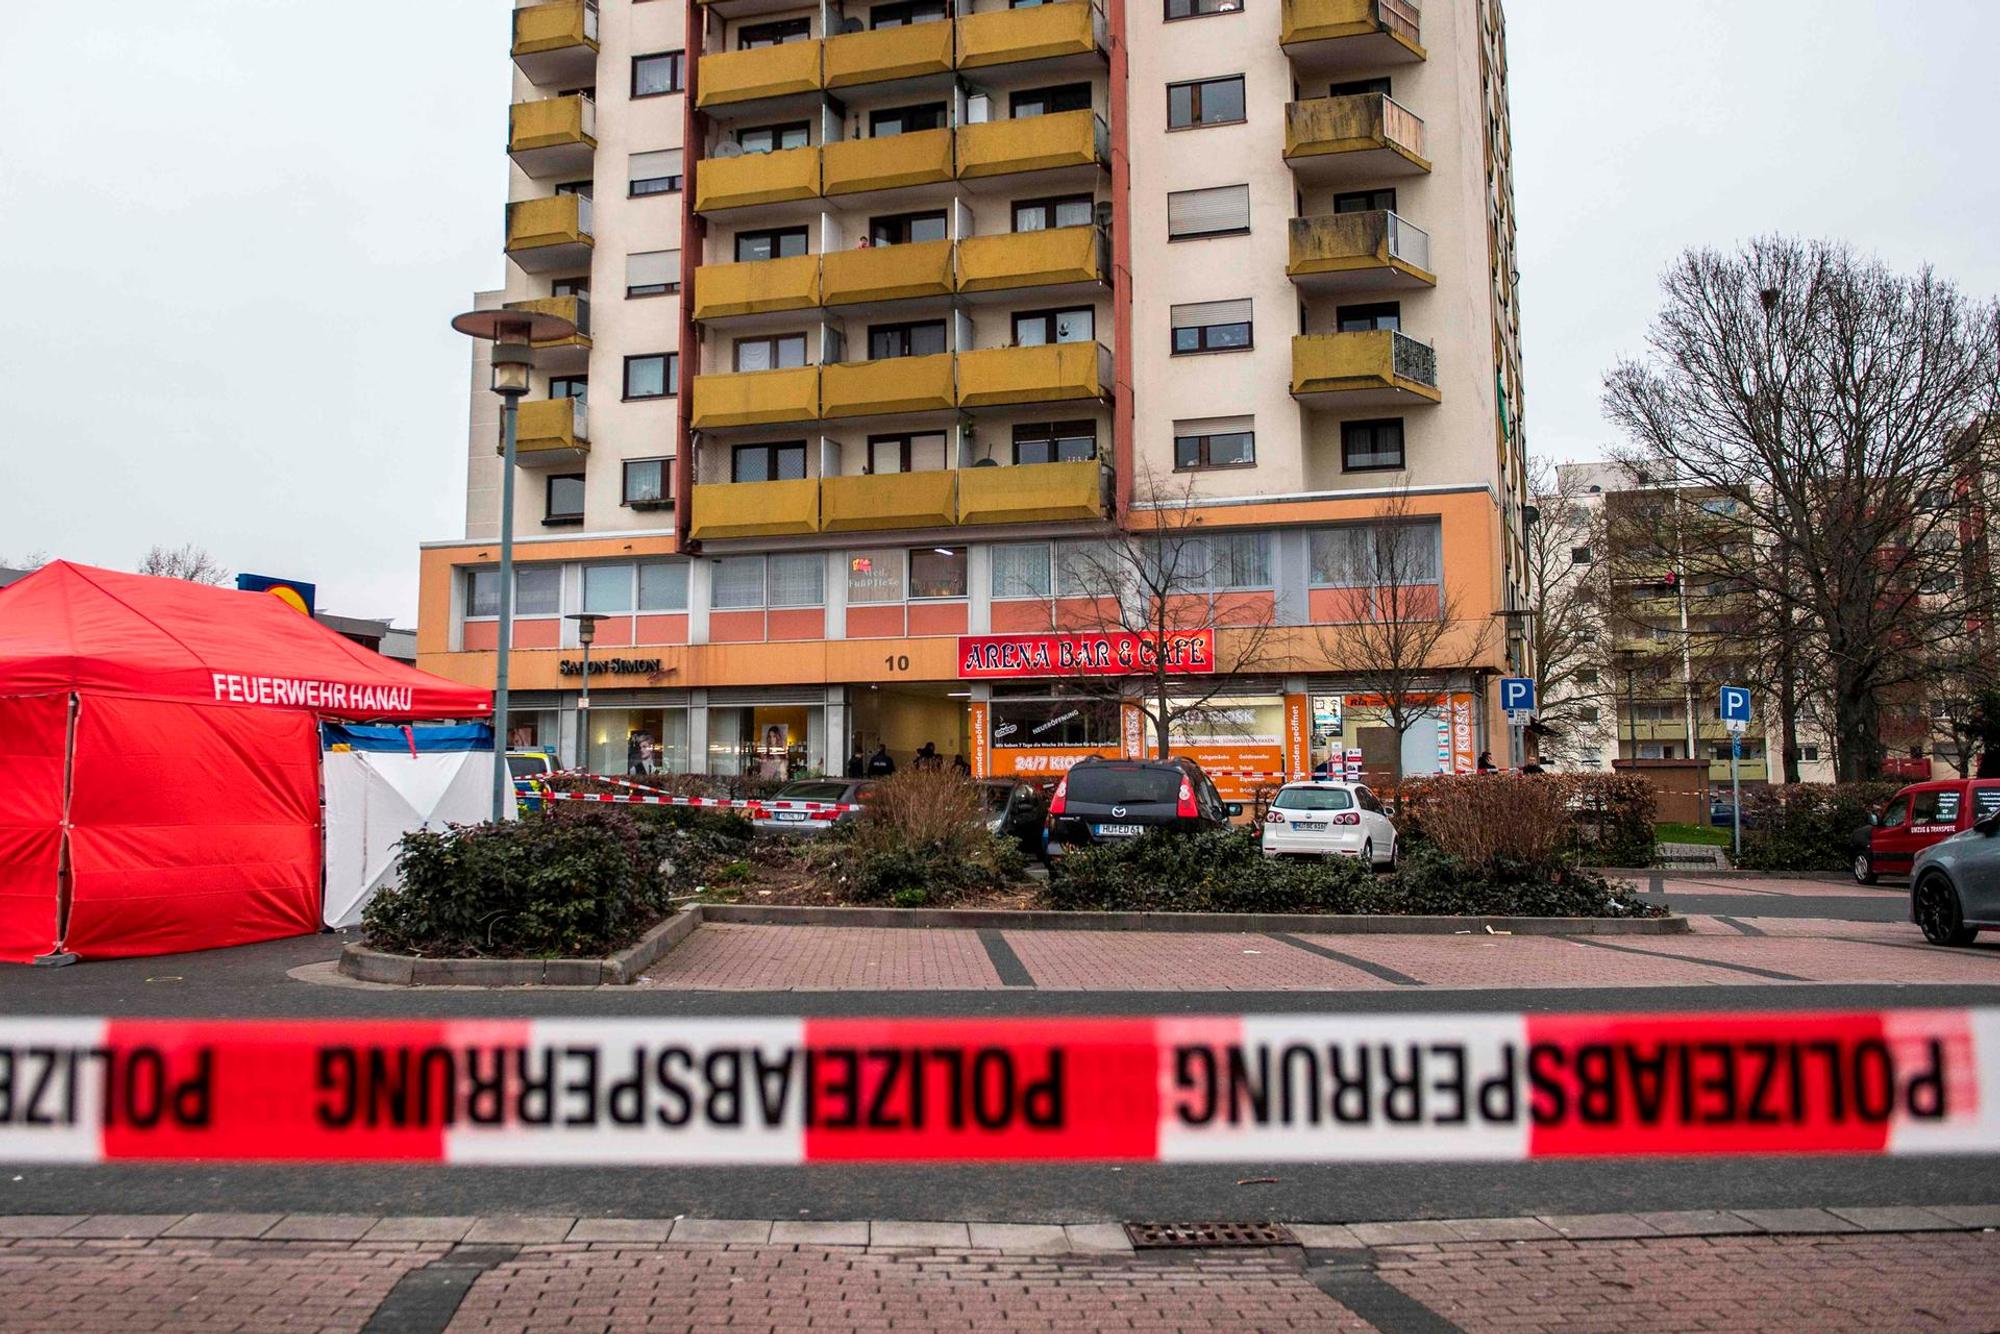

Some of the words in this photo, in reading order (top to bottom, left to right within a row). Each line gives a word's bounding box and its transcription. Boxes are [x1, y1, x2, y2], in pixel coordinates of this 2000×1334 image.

[609, 657, 662, 674] SIMON
[884, 655, 909, 672] 10
[965, 641, 1050, 670] ARENA
[1058, 640, 1110, 668] BAR
[1119, 639, 1133, 666] &
[212, 673, 348, 709] FEUERWEHR
[349, 684, 413, 711] HANAU
[1508, 682, 1526, 707] P
[1727, 691, 1743, 717] P
[976, 710, 984, 745] geöffnet
[1032, 709, 1079, 735] NEUERÖFFNUNG
[1292, 705, 1301, 742] geöffnet
[1454, 701, 1470, 752] KIOSK
[1015, 755, 1048, 771] 24/7
[1049, 755, 1087, 771] KIO
[1292, 742, 1300, 780] Sunden
